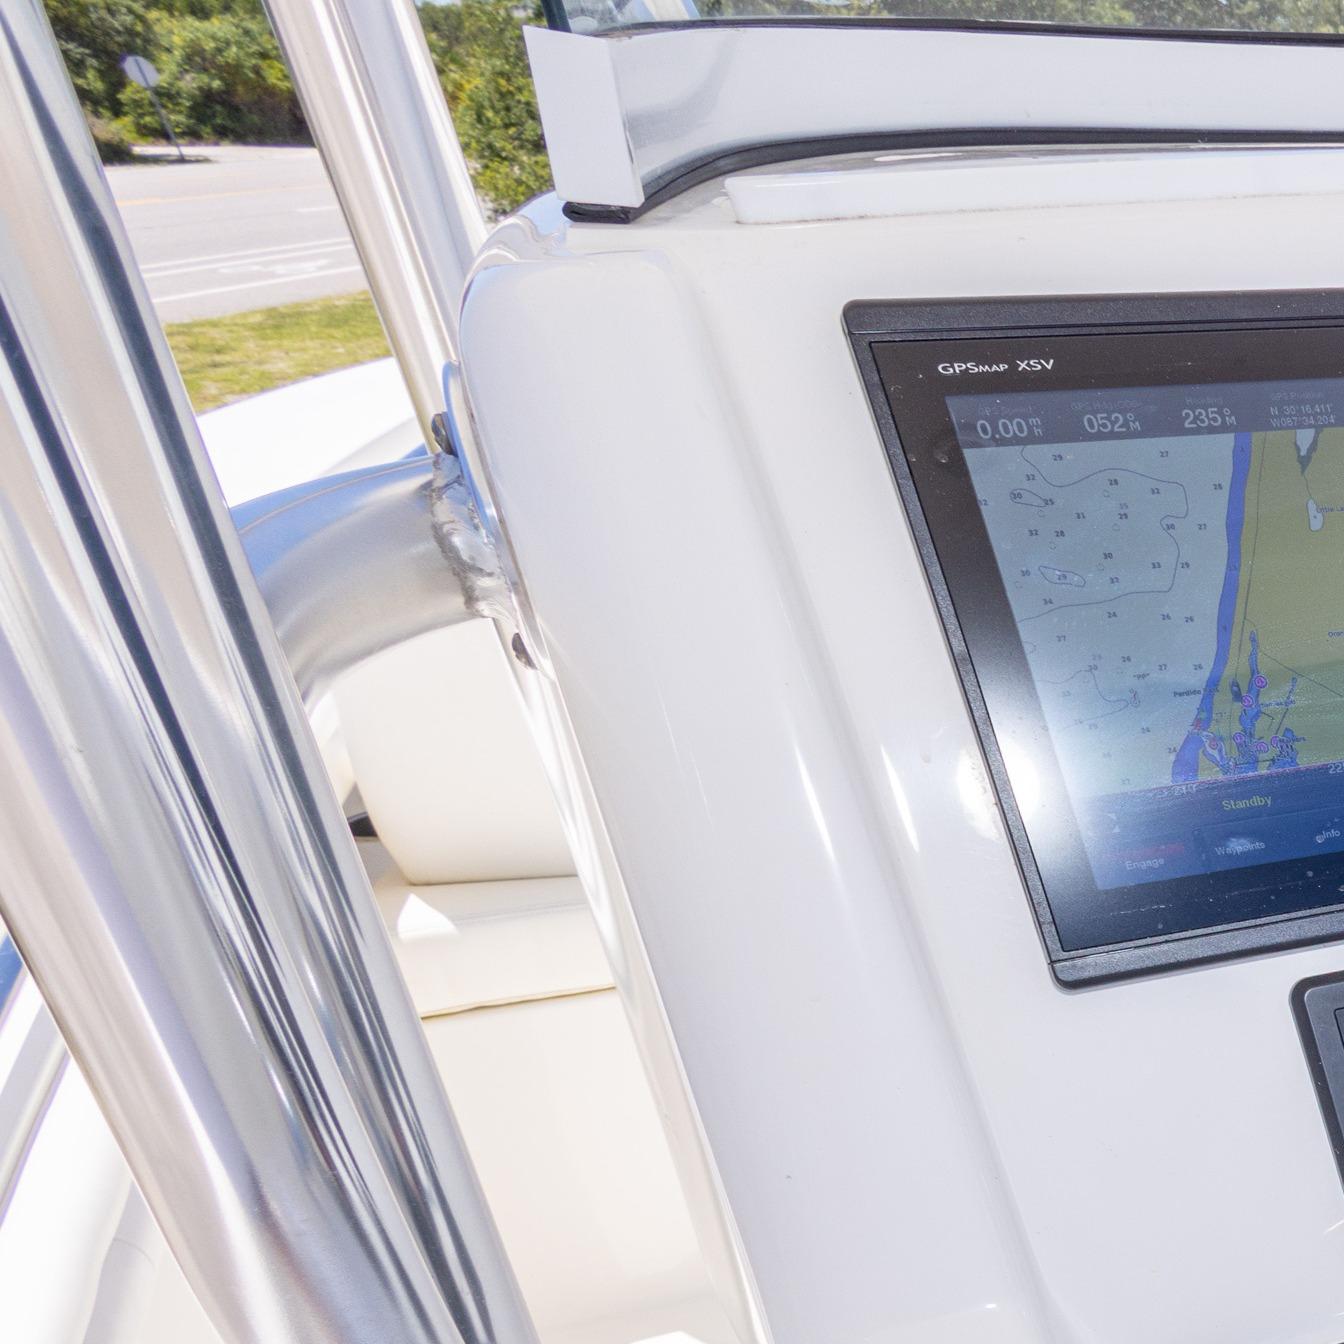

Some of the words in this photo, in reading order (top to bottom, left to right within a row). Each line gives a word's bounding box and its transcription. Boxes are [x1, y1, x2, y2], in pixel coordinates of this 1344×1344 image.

[938, 363, 1008, 374] GPSMAP
[1016, 359, 1054, 372] XSV
[1084, 414, 1126, 433] 052
[1182, 408, 1222, 428] 235
[976, 418, 1028, 439] 0.00
[1222, 795, 1272, 812] Standby
[1322, 828, 1341, 839] Info
[1214, 840, 1266, 856] Waypoints
[1126, 857, 1164, 872] Engage
